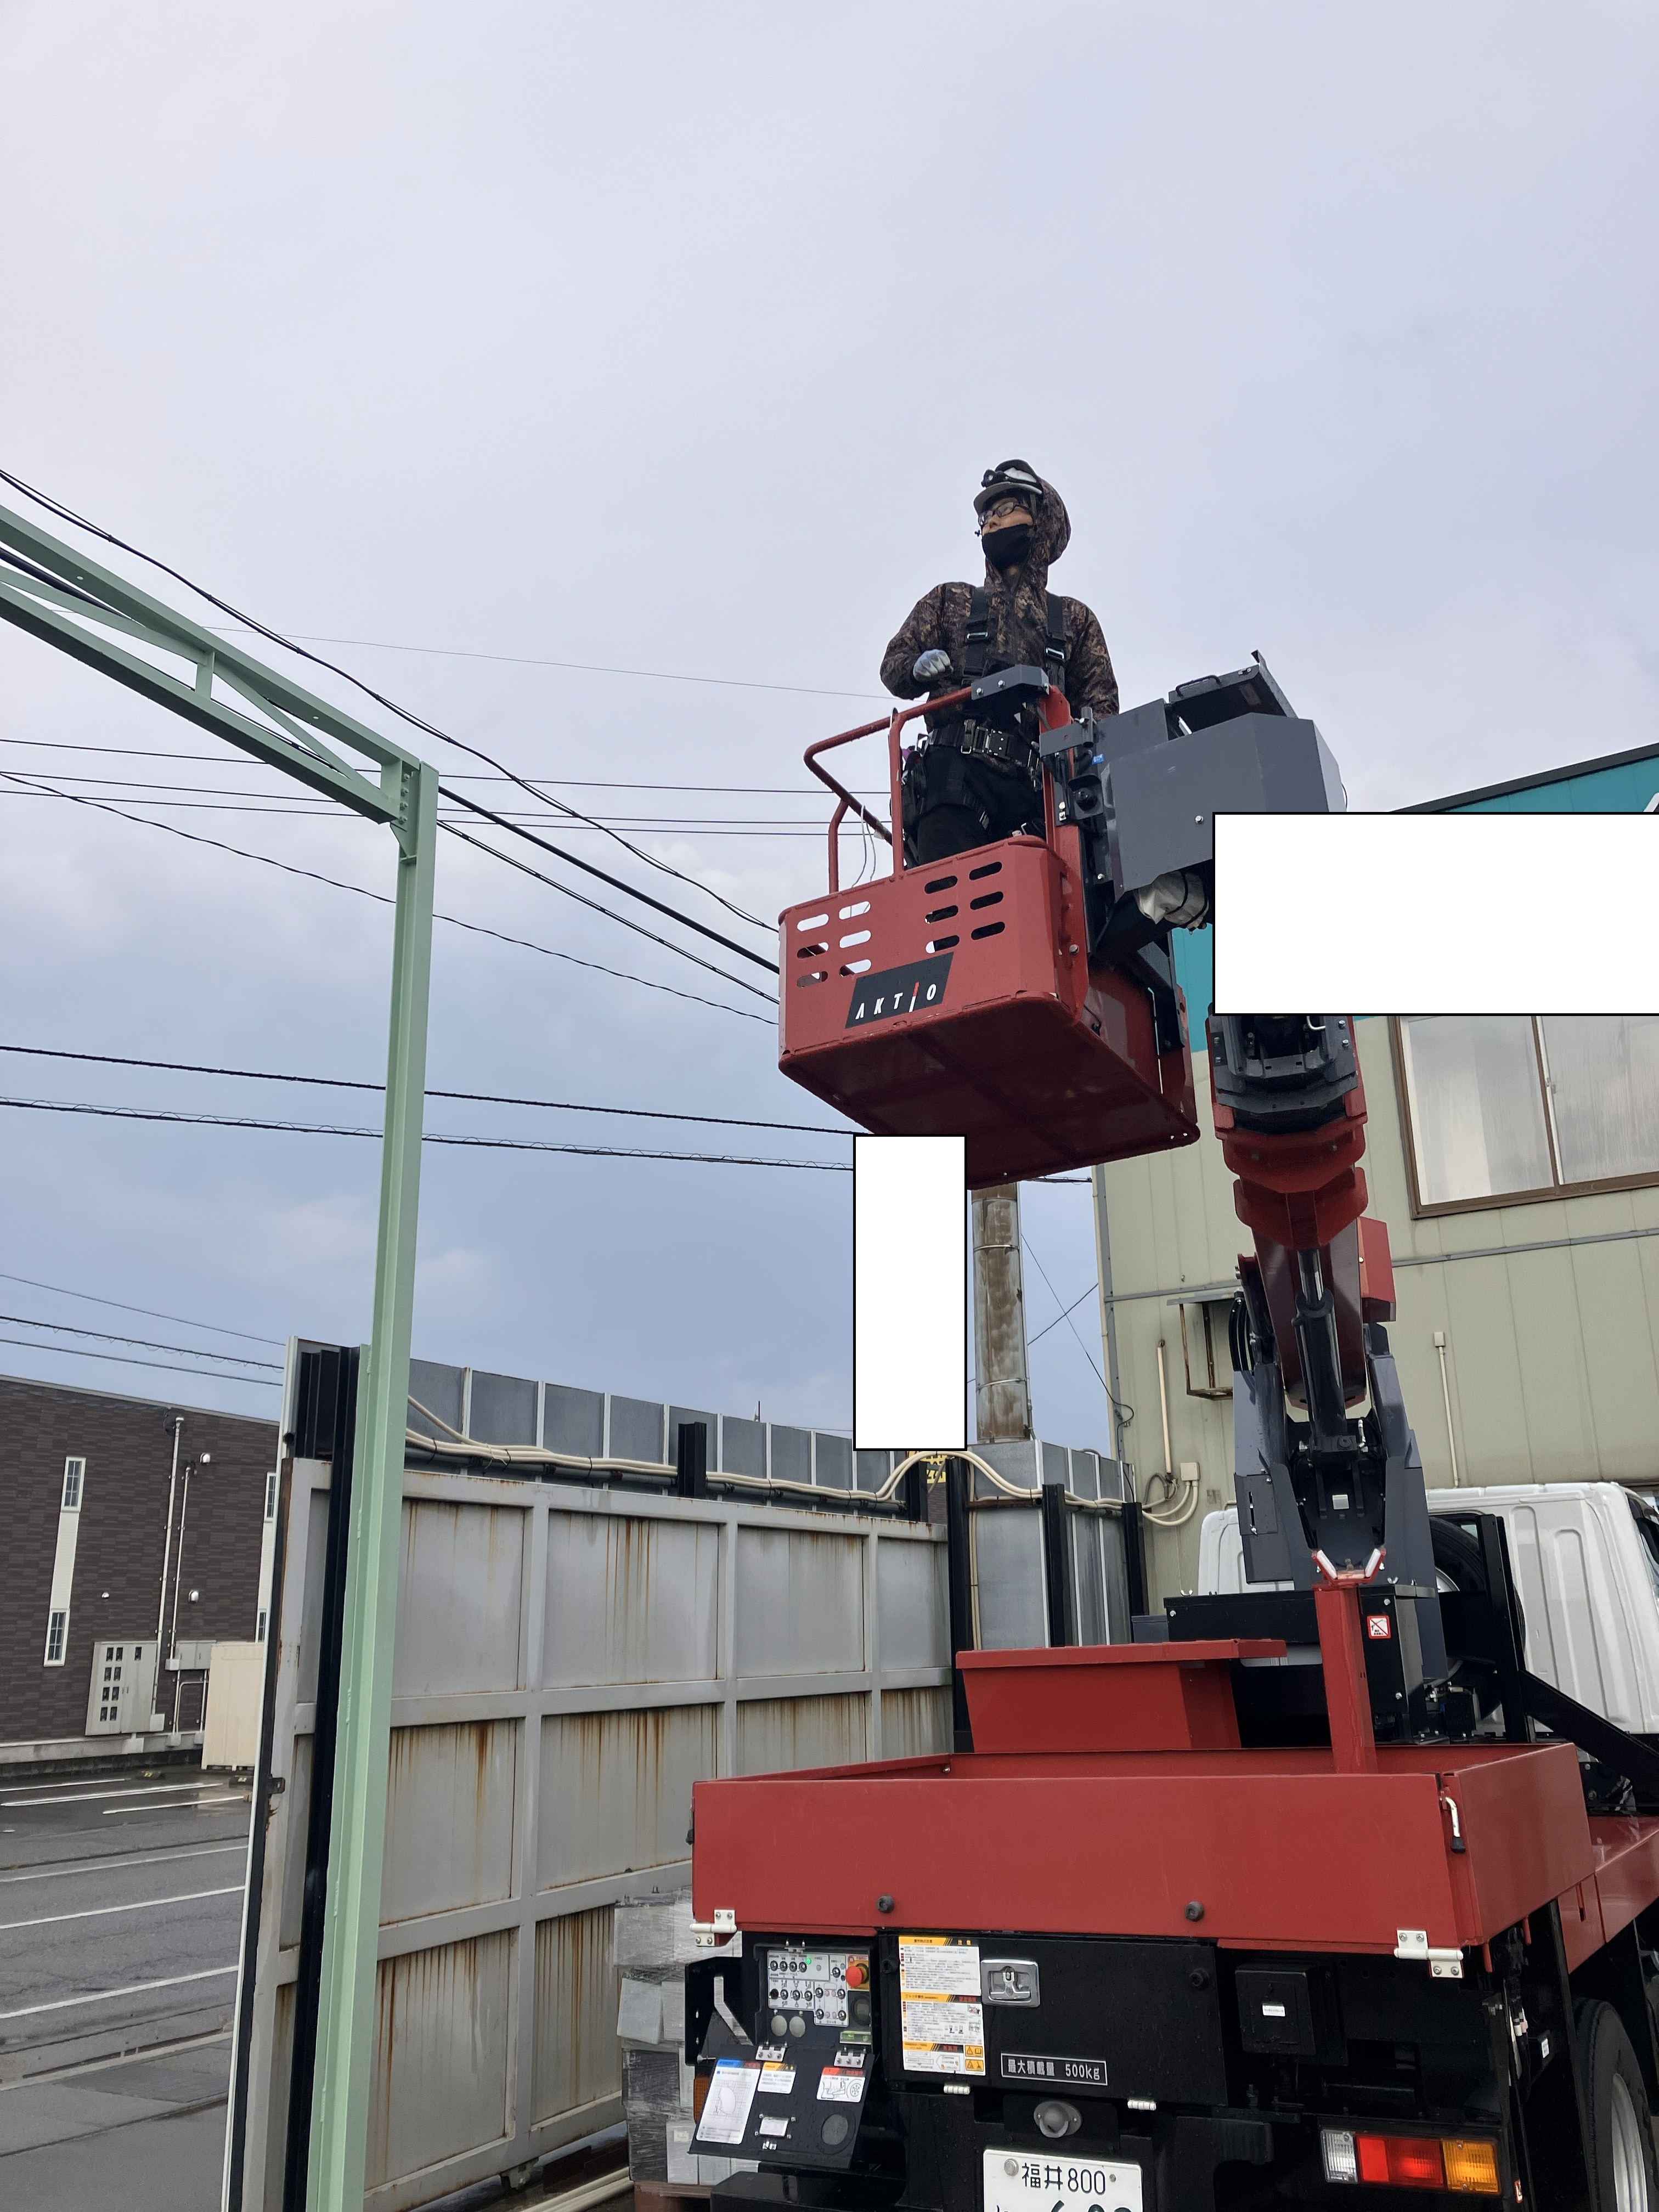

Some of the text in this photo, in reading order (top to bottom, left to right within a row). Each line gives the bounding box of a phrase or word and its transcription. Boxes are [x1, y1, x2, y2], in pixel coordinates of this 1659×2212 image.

[1008, 2059, 1101, 2081] 最大積載量 500kg
